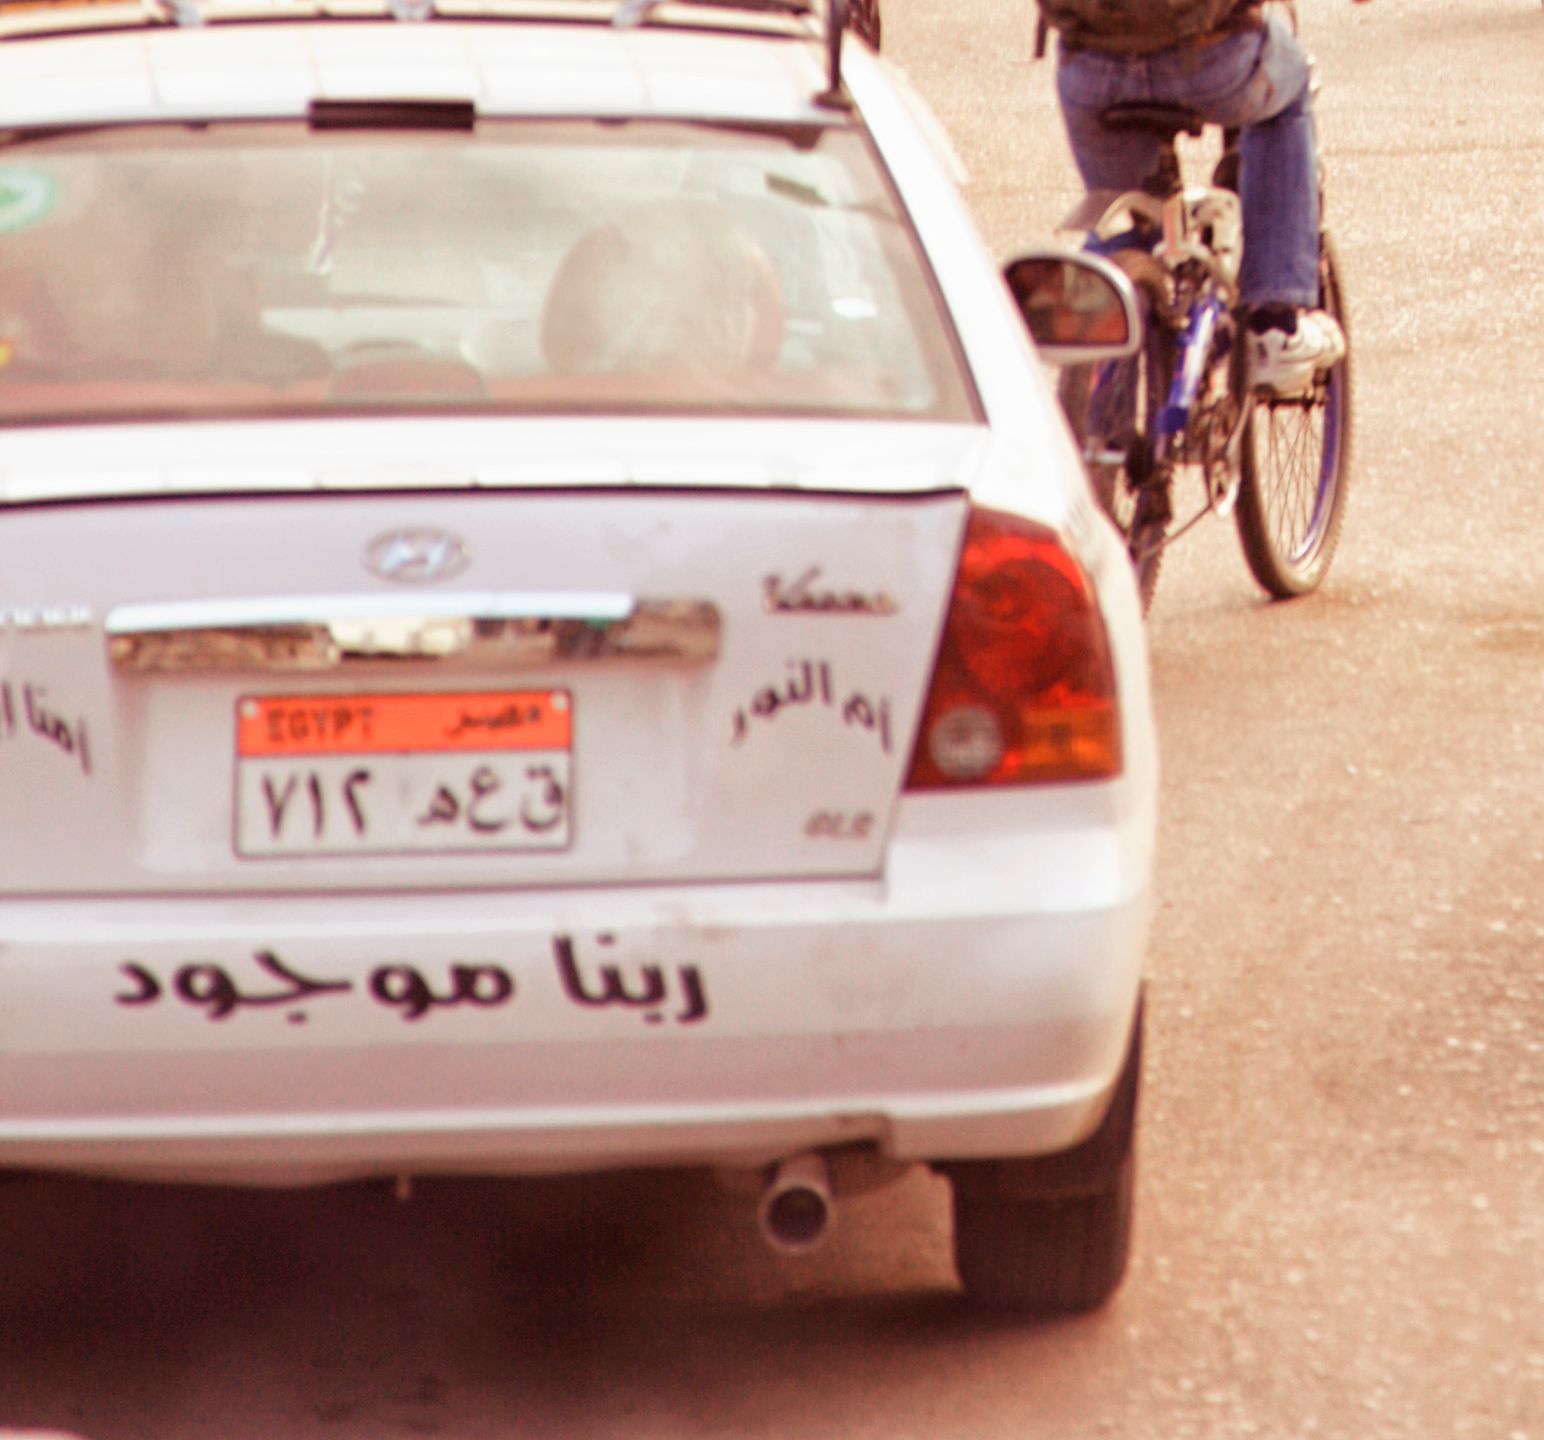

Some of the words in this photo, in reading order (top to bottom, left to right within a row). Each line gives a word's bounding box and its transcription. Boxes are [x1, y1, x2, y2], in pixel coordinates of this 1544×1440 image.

[266, 705, 373, 742] EGYPT
[444, 704, 542, 740] مصر
[261, 767, 373, 839] ٧١٢
[112, 948, 517, 1025] موجود
[552, 934, 711, 1024] ربنا
